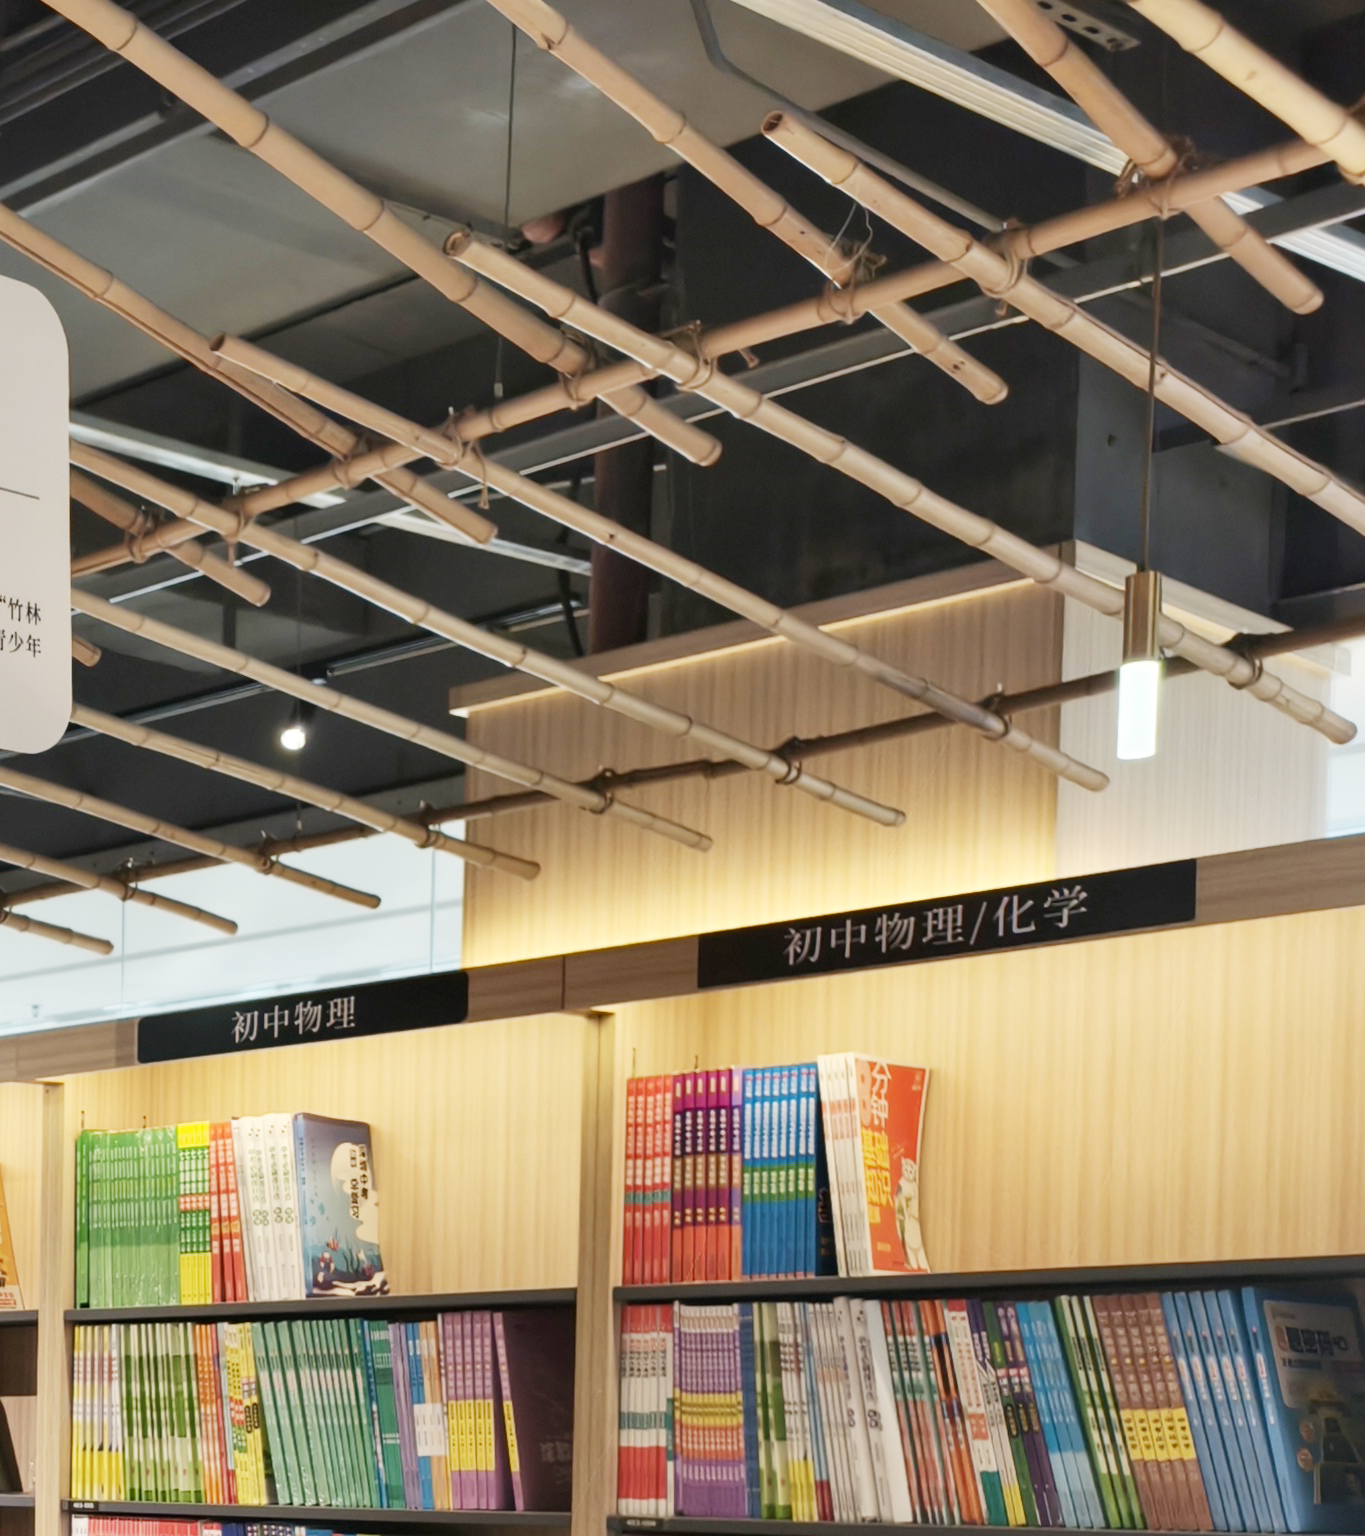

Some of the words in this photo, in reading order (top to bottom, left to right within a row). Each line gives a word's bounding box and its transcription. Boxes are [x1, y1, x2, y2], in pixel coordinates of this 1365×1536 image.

[781, 885, 1089, 965] 初中物理/化学
[230, 997, 357, 1044] 初中物理
